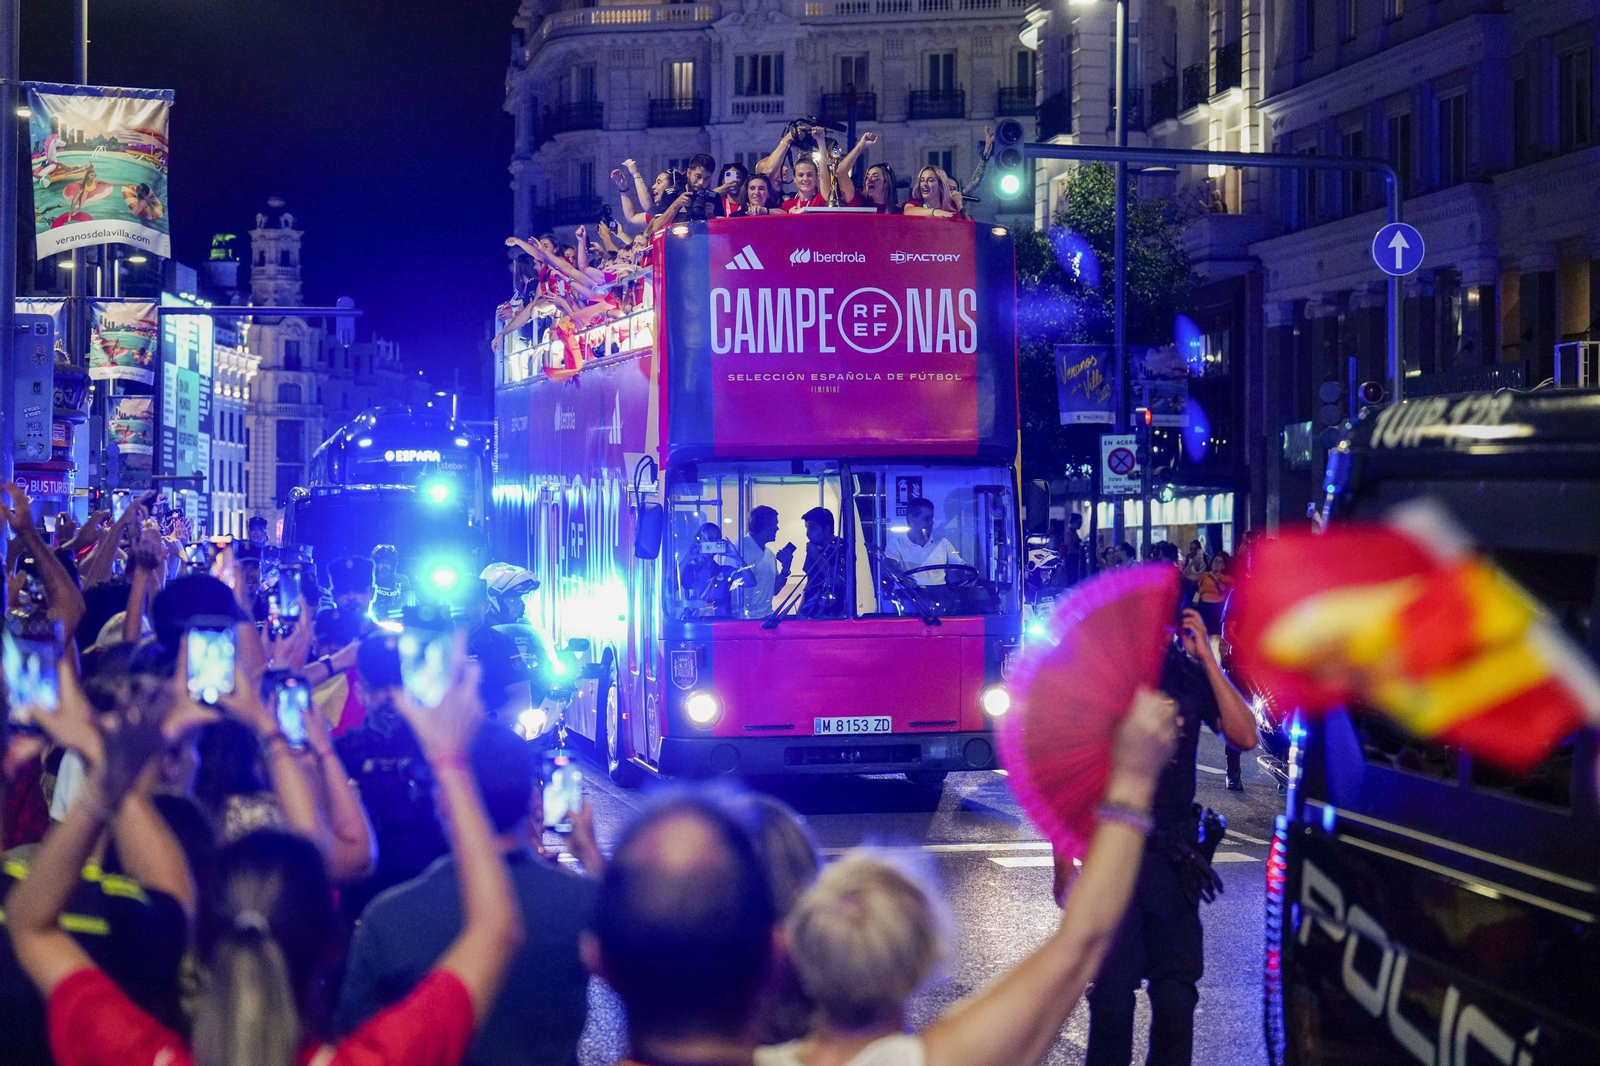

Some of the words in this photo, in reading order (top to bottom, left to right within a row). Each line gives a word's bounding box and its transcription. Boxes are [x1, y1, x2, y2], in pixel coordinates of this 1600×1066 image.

[55, 228, 151, 246] veranosdelavilla.com
[813, 251, 866, 263] Iberdrola
[727, 371, 805, 382] SELECCIÓN
[811, 371, 882, 381] ESPAÑOLA
[887, 373, 905, 381] DE
[909, 371, 963, 381] FÚTBOL
[30, 480, 49, 493] BUS
[822, 719, 831, 732] M
[836, 719, 869, 732] 8153
[874, 718, 890, 732] ZD
